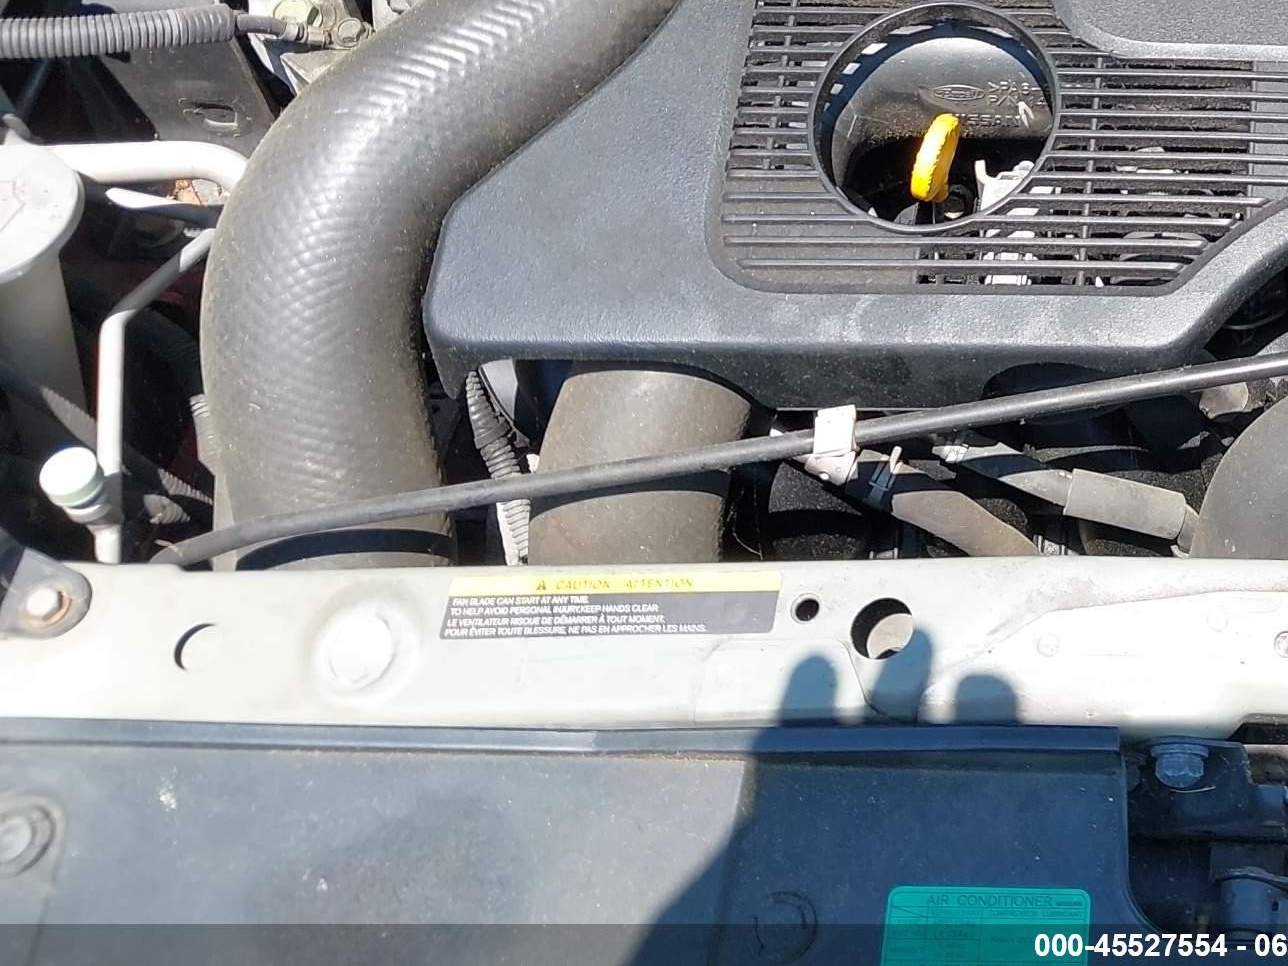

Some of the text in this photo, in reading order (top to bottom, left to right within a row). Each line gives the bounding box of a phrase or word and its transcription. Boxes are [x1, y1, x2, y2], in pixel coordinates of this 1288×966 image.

[555, 578, 693, 590] CAUTION ATTENTION
[452, 597, 469, 606] FAN
[469, 597, 496, 606] BLADE
[496, 597, 515, 605] CAN
[515, 596, 540, 604] START
[540, 596, 552, 604] AT
[551, 595, 570, 604] ANY
[450, 607, 461, 616] TO
[462, 607, 484, 615] HELP
[484, 607, 508, 615] AVOID
[509, 606, 552, 615] PERSONAL
[602, 604, 630, 612] HANDS
[447, 618, 458, 626] LE
[458, 617, 509, 626] VENTILATEUR
[510, 617, 540, 625] RISQUE
[541, 616, 553, 625] DE
[598, 613, 605, 623] À
[606, 614, 628, 623] TOUT
[444, 628, 468, 636] POUR
[469, 625, 496, 636] ÉVITER
[497, 627, 523, 635] TOUTE
[568, 626, 580, 634] NE
[581, 626, 597, 634] PAS
[598, 625, 610, 633] EN
[611, 625, 661, 633] APPROCHER
[662, 624, 679, 633] LES
[926, 894, 949, 906] AIR
[956, 894, 1054, 907] CONDITIONER
